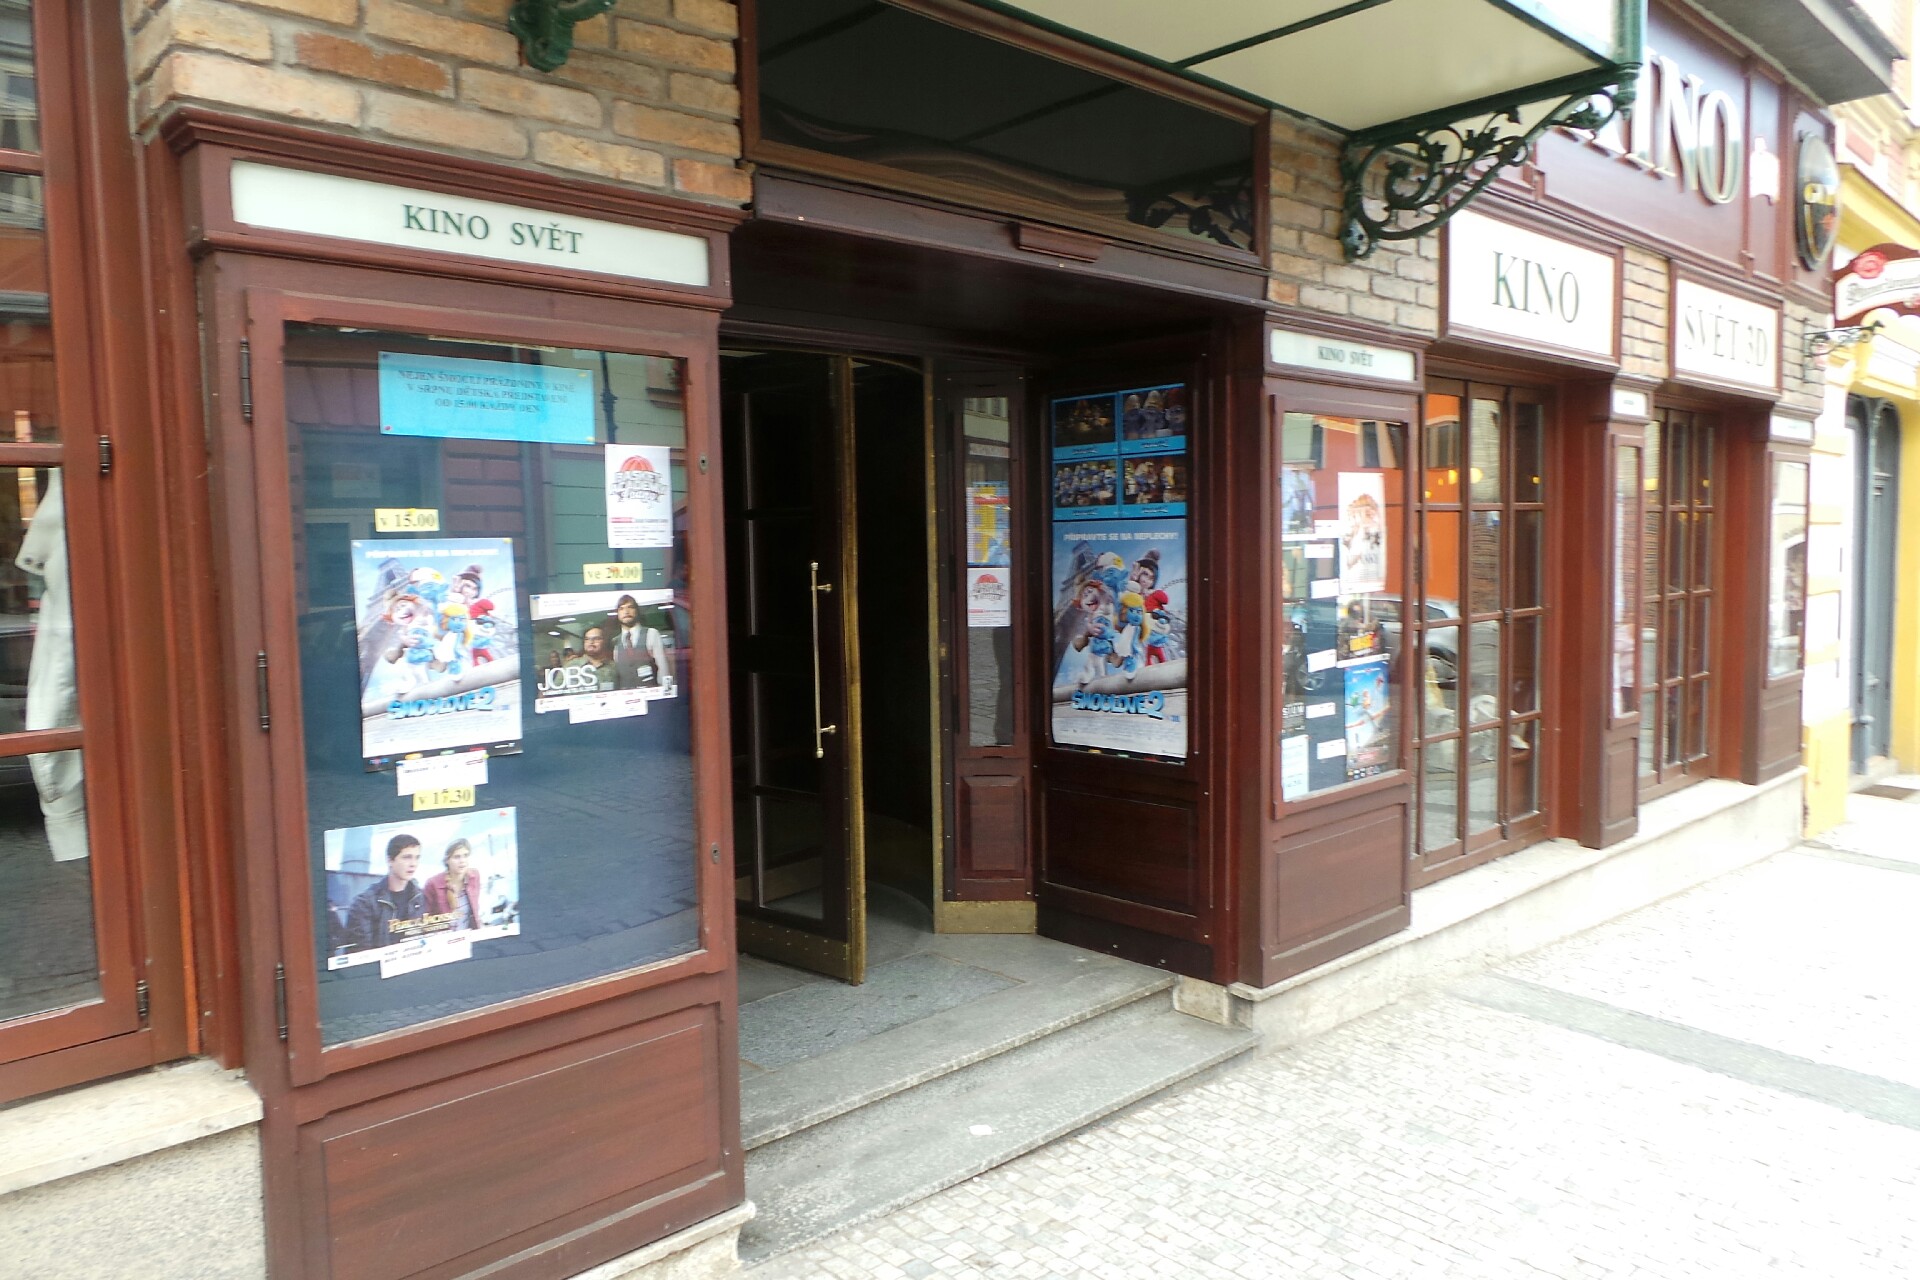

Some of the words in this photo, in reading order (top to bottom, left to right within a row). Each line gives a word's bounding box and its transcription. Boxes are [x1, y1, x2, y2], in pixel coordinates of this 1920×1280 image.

[403, 203, 490, 240] KINO
[510, 222, 583, 254] SVĚT
[1491, 250, 1580, 323] KINO
[1318, 345, 1345, 363] KINO
[1350, 350, 1375, 367] SVĚT
[1744, 324, 1768, 367] 3D
[380, 517, 388, 527] v
[394, 513, 436, 527] 15.00
[605, 566, 640, 579] 20.00
[537, 664, 598, 691] JOBS
[473, 686, 496, 712] 2
[1144, 690, 1166, 720] 2
[432, 788, 472, 805] 17.30
